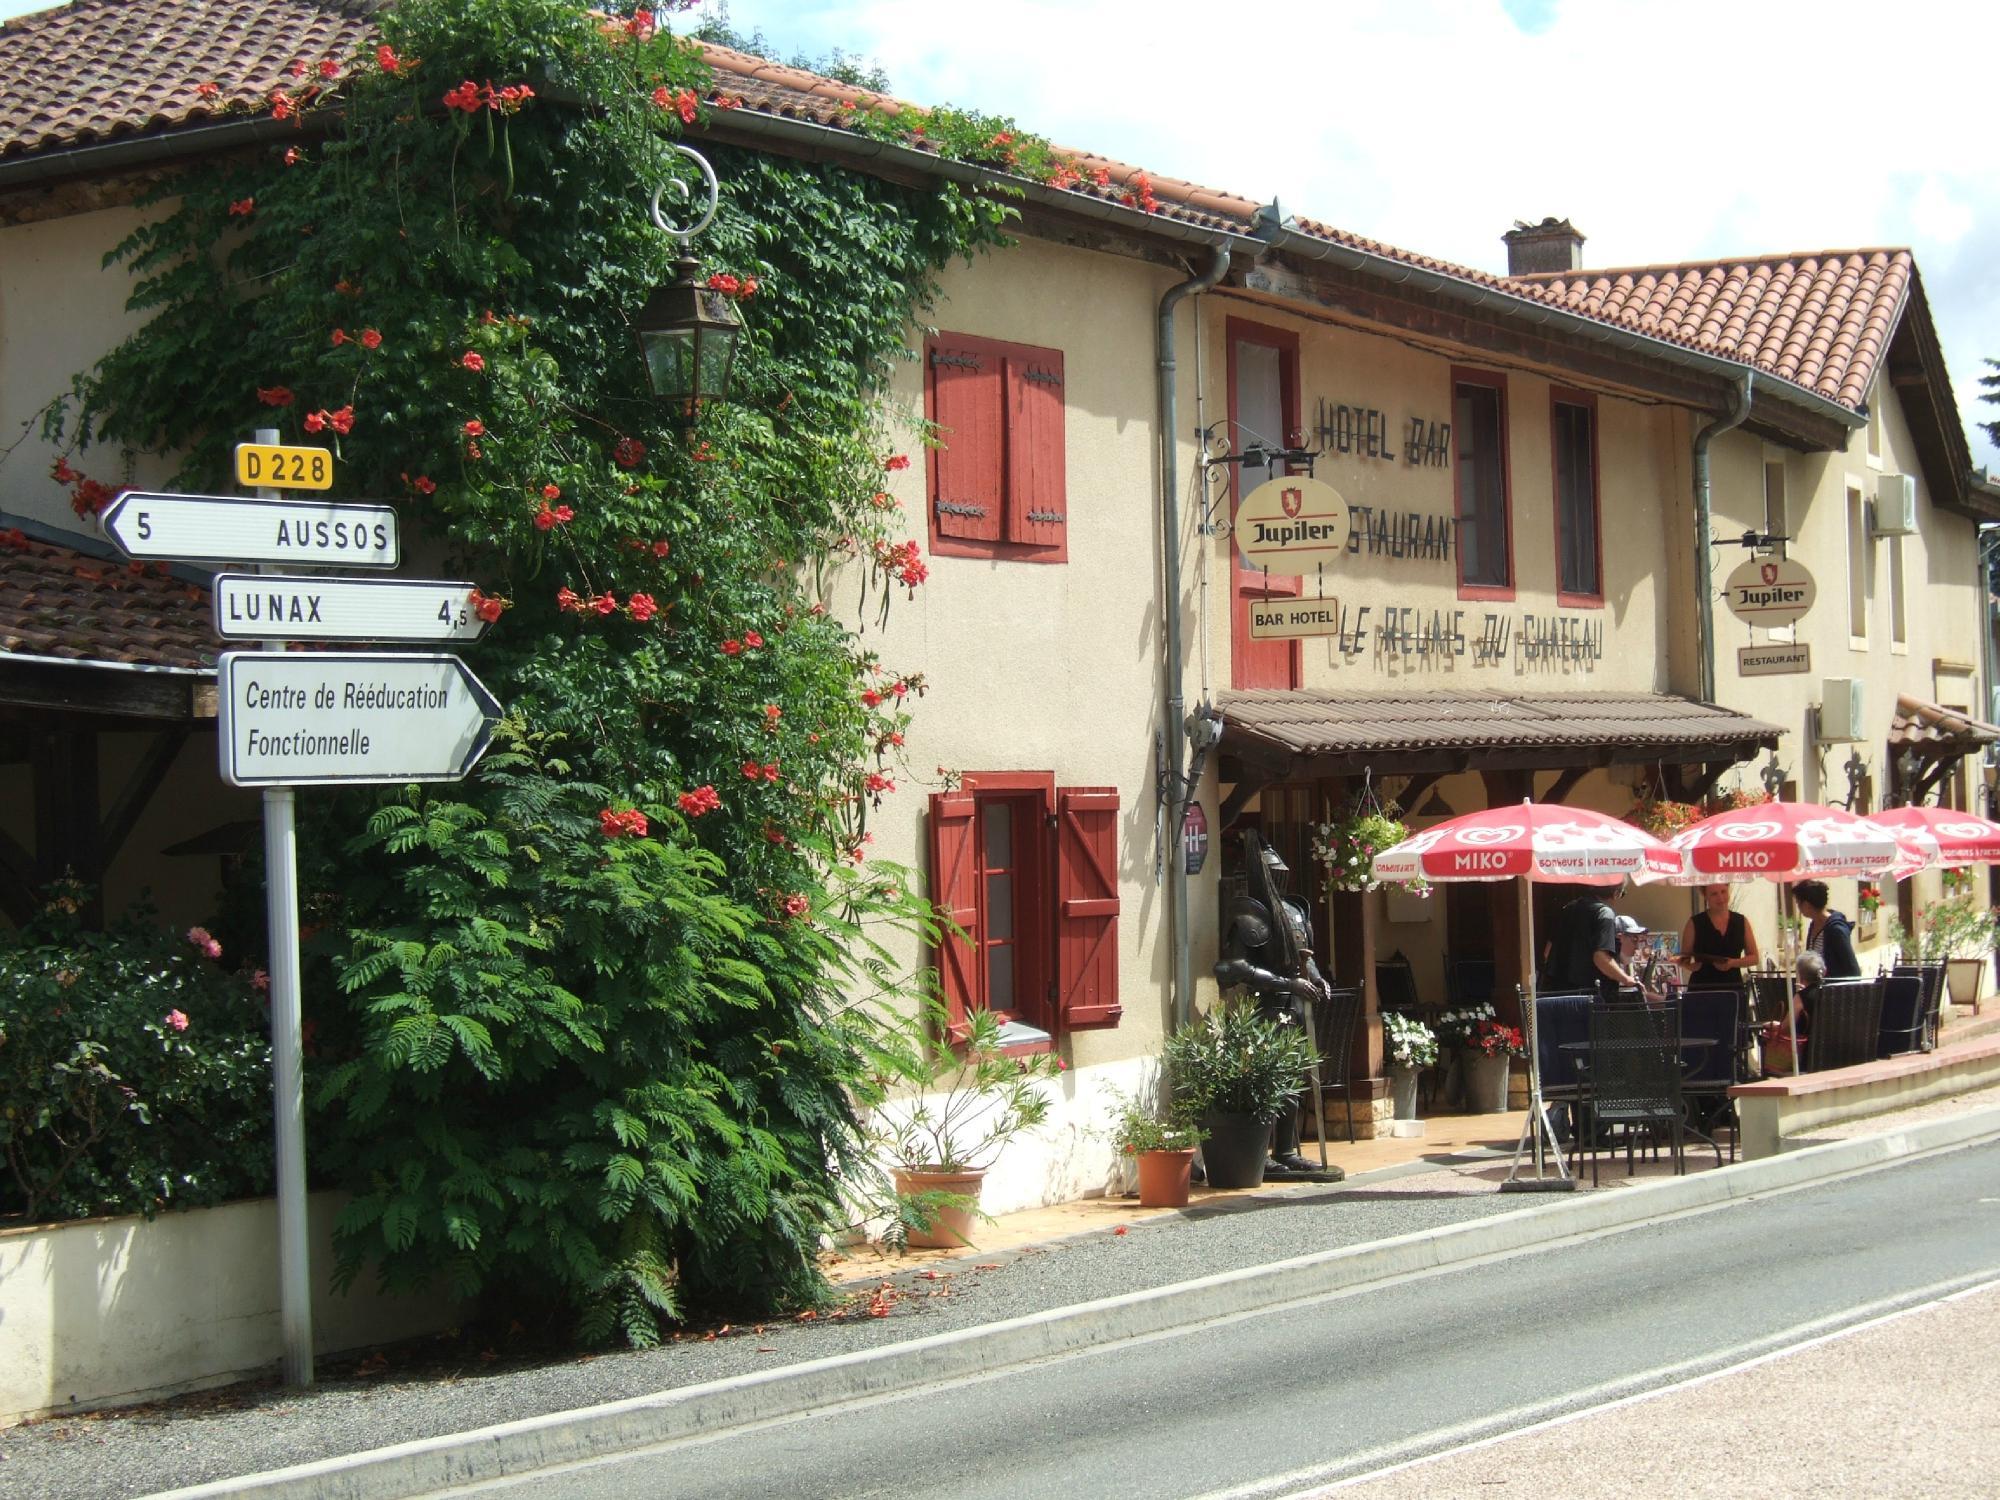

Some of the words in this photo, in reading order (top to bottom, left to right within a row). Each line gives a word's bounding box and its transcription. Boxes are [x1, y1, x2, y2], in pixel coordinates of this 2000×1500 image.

[1318, 396, 1396, 461] HOTEL
[1410, 416, 1451, 468] BAR
[248, 452, 261, 479] D
[272, 453, 325, 482] 228
[137, 512, 152, 541] 5
[276, 519, 388, 550] AUSSOS
[1251, 520, 1335, 547] Jupiler
[1347, 505, 1461, 562] STAURANT
[229, 592, 322, 623] LUNAX
[1738, 588, 1804, 607] Jupiler
[1255, 613, 1284, 627] BAR
[1290, 610, 1334, 625] HOTEL
[1338, 603, 1371, 654] LE
[1382, 606, 1465, 656] RELAIS
[1478, 614, 1511, 659] DU
[1743, 654, 1806, 667] RESTAURANT
[246, 680, 307, 710] Centre
[314, 681, 335, 710] de
[343, 681, 448, 710] Rééducation
[247, 728, 371, 757] Fonctionnelle
[1454, 851, 1508, 870] MIKO
[1717, 851, 1770, 868] MIKO
